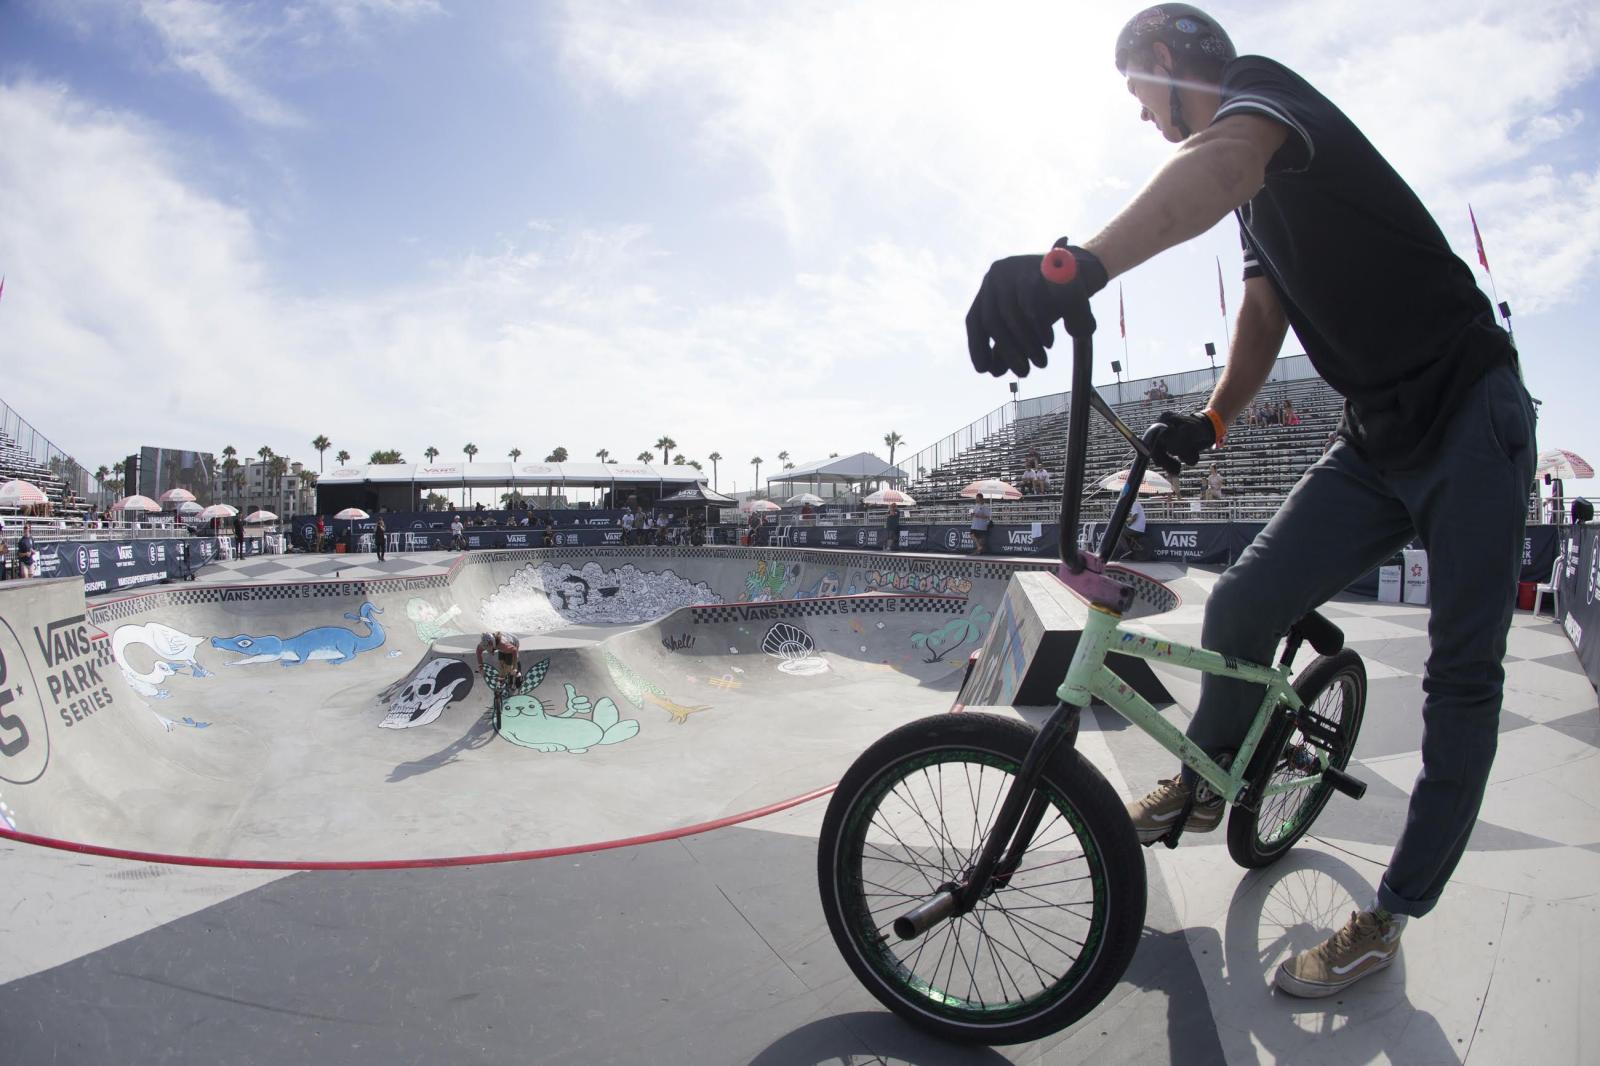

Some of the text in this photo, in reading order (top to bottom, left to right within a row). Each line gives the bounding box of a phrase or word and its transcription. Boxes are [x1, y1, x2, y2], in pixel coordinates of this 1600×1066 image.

[506, 534, 527, 542] VANS
[824, 530, 838, 540] VANS
[1008, 531, 1033, 544] VANS
[1161, 531, 1198, 547] VANS
[117, 546, 132, 559] VANS
[593, 549, 616, 557] VANS
[908, 560, 932, 574] VANS
[85, 581, 106, 592] SUSOPEN
[401, 580, 426, 591] VANS
[219, 588, 250, 602] VANS
[87, 606, 111, 626] VANS
[737, 605, 779, 622] VANS
[34, 614, 91, 668] VANS
[46, 659, 103, 705] PARK
[60, 686, 114, 728] SERIES
